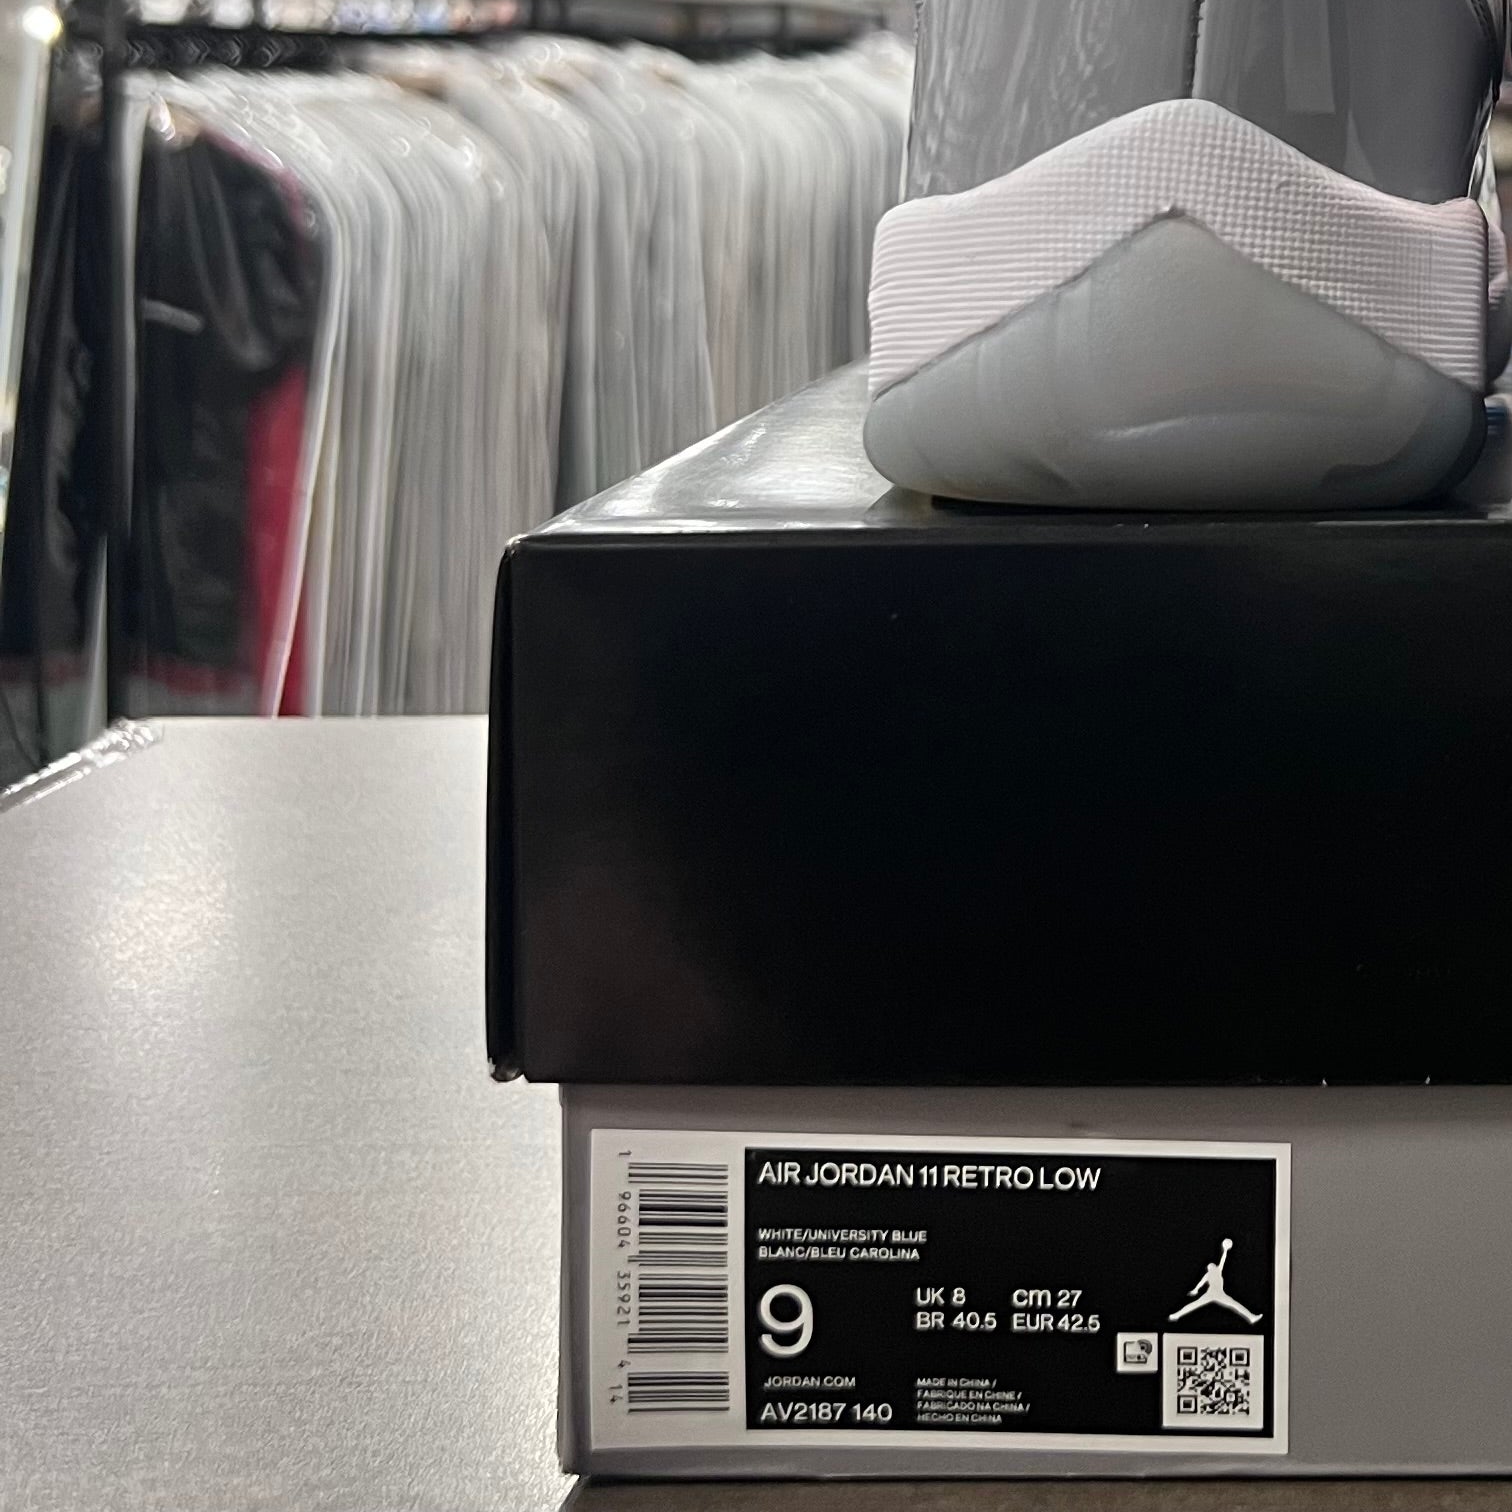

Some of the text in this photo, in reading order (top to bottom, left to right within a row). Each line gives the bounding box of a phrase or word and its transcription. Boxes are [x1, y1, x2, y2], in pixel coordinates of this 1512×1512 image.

[757, 1161, 1101, 1191] AIR JORDAN 11 RETRO LOW
[617, 1191, 632, 1249] 96604
[758, 1228, 928, 1244] WHITE/UNIVERSITY BLUE
[758, 1246, 921, 1261] BLANC/BLEU CAROLINA
[617, 1271, 631, 1326] 35921
[916, 1287, 966, 1307] UK 8
[1057, 1290, 1083, 1308] 27
[759, 1283, 814, 1357] 9
[916, 1311, 998, 1332] BR 40.5
[1012, 1313, 1101, 1333] EUR 42.5
[917, 1378, 946, 1388] MADE
[948, 1378, 958, 1388] IN
[959, 1378, 990, 1388] CHINA
[969, 1391, 983, 1400] EN
[760, 1402, 893, 1423] AV2187 140
